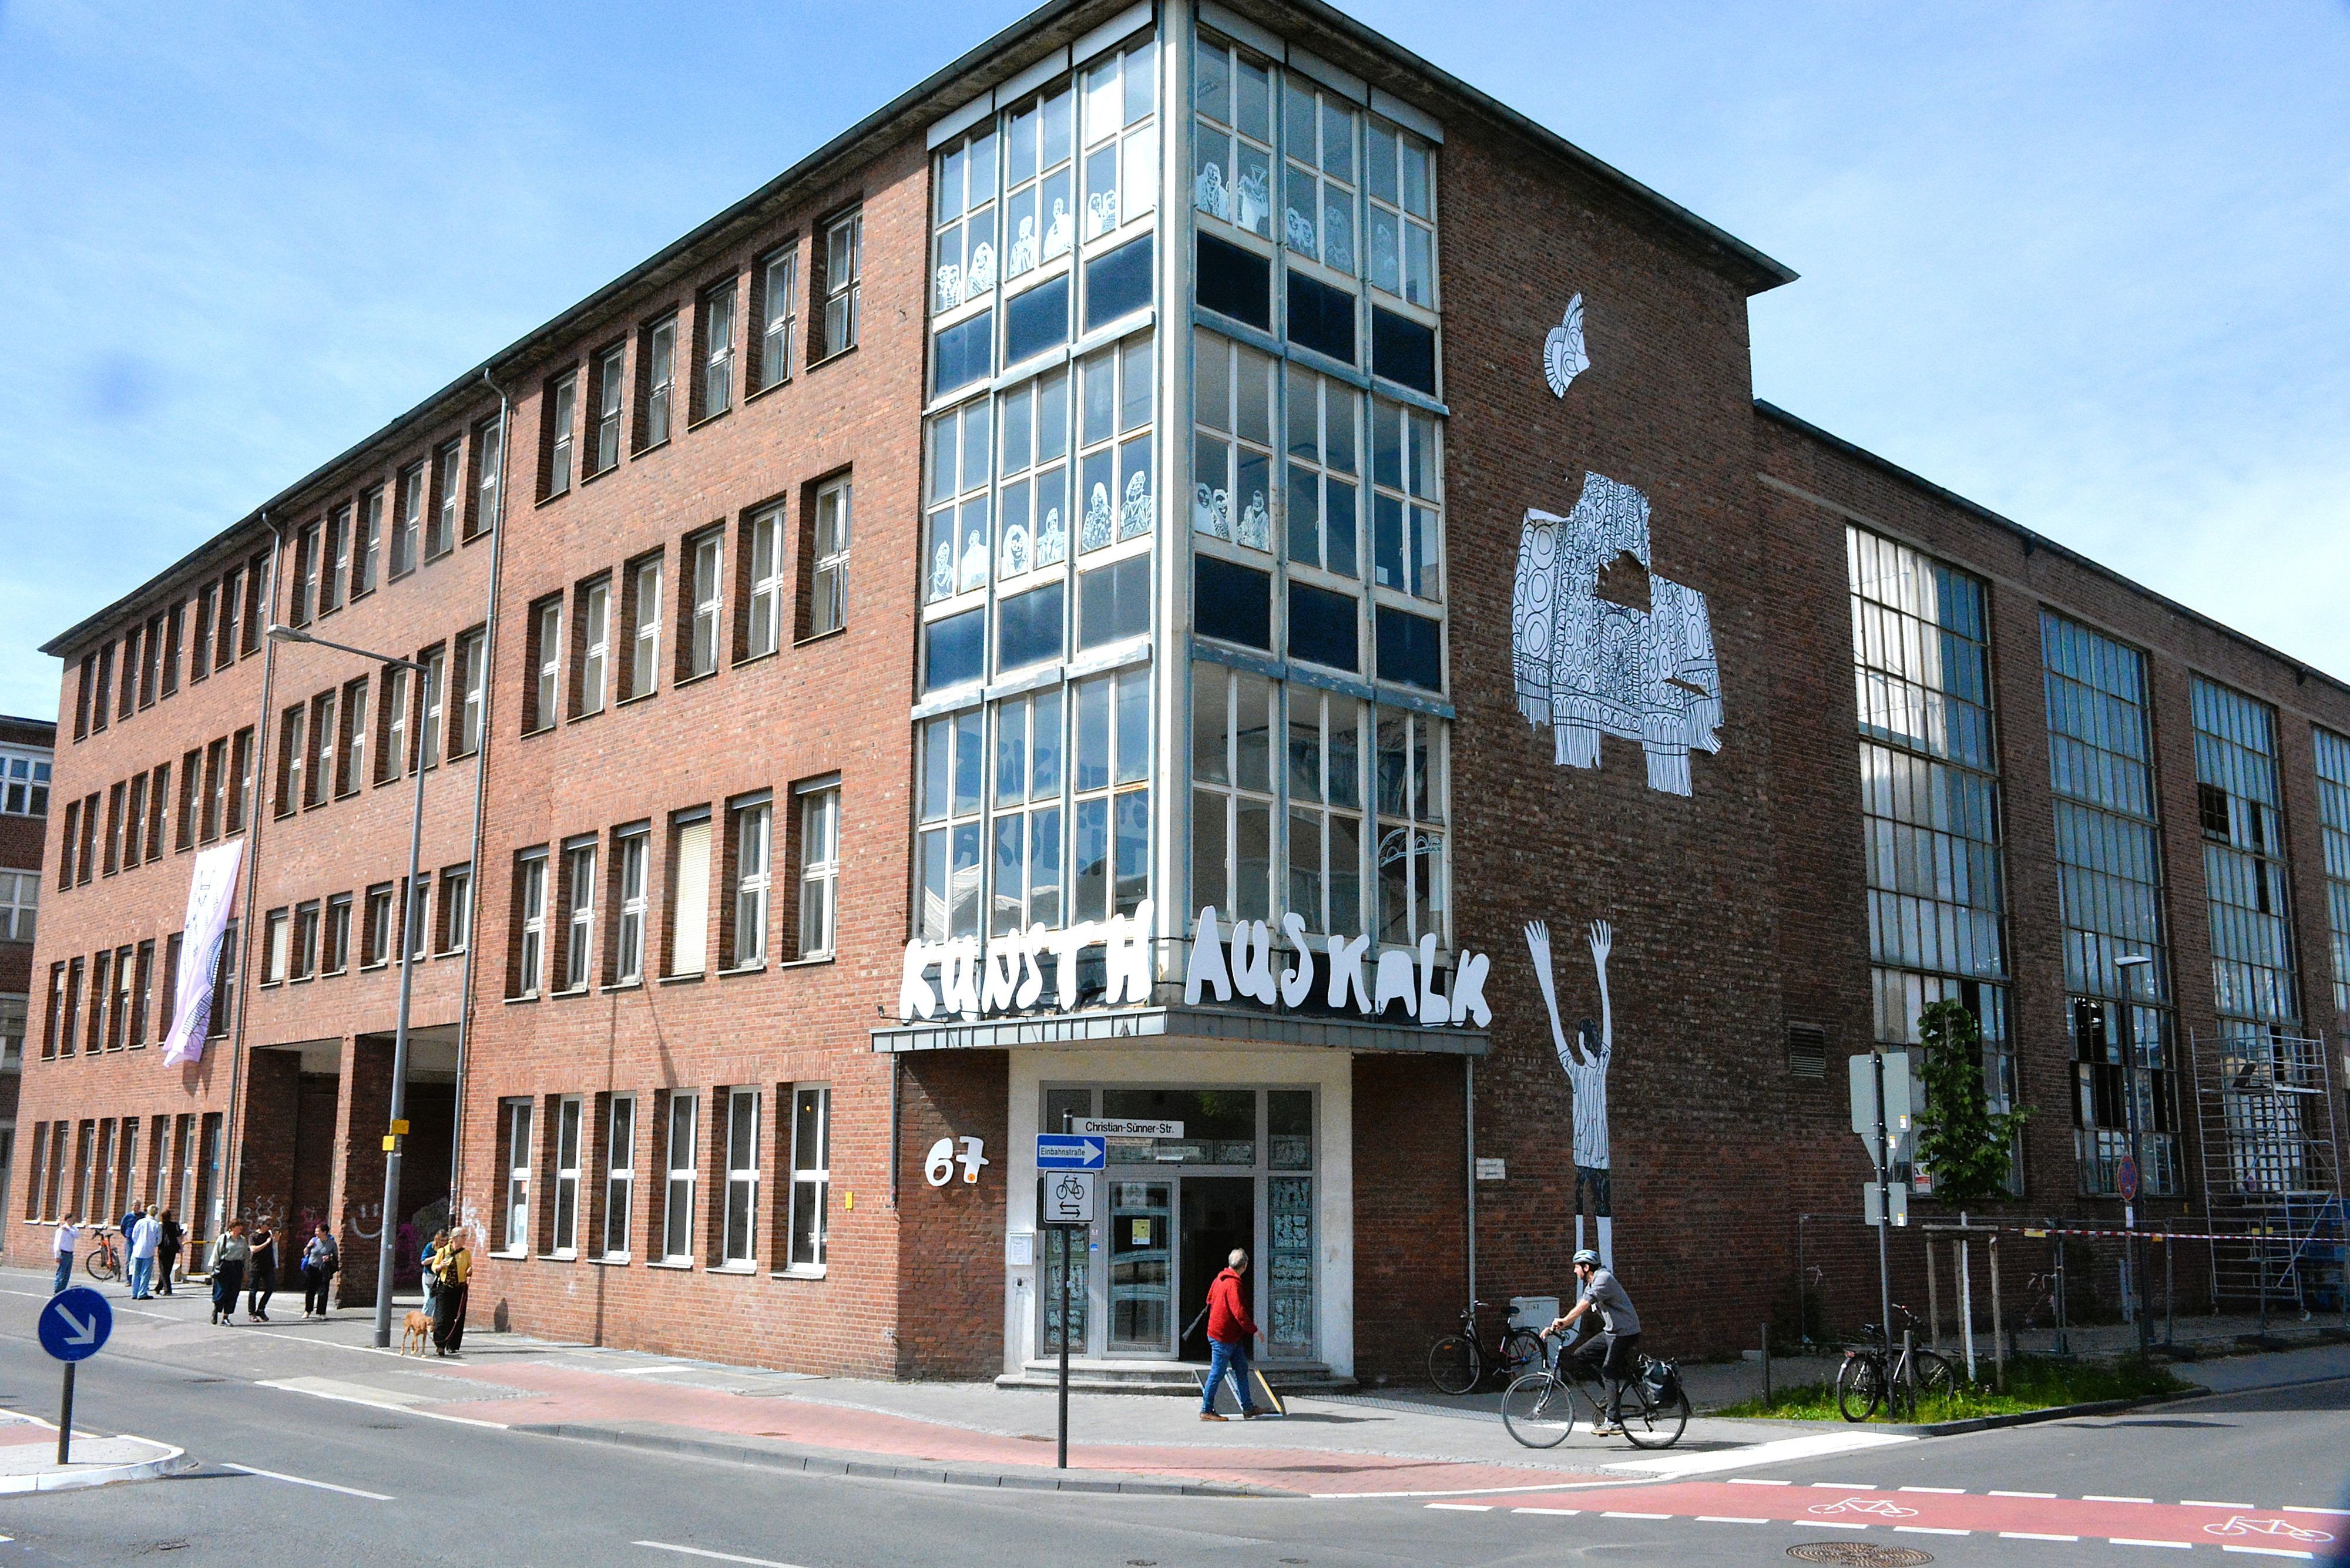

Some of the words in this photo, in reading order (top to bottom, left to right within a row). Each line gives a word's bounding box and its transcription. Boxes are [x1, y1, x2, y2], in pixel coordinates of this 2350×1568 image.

[1086, 1121, 1174, 1134] Christian-Sünner-Str.
[1040, 1147, 1086, 1156] Einbahnstraße
[925, 1136, 989, 1187] 67
